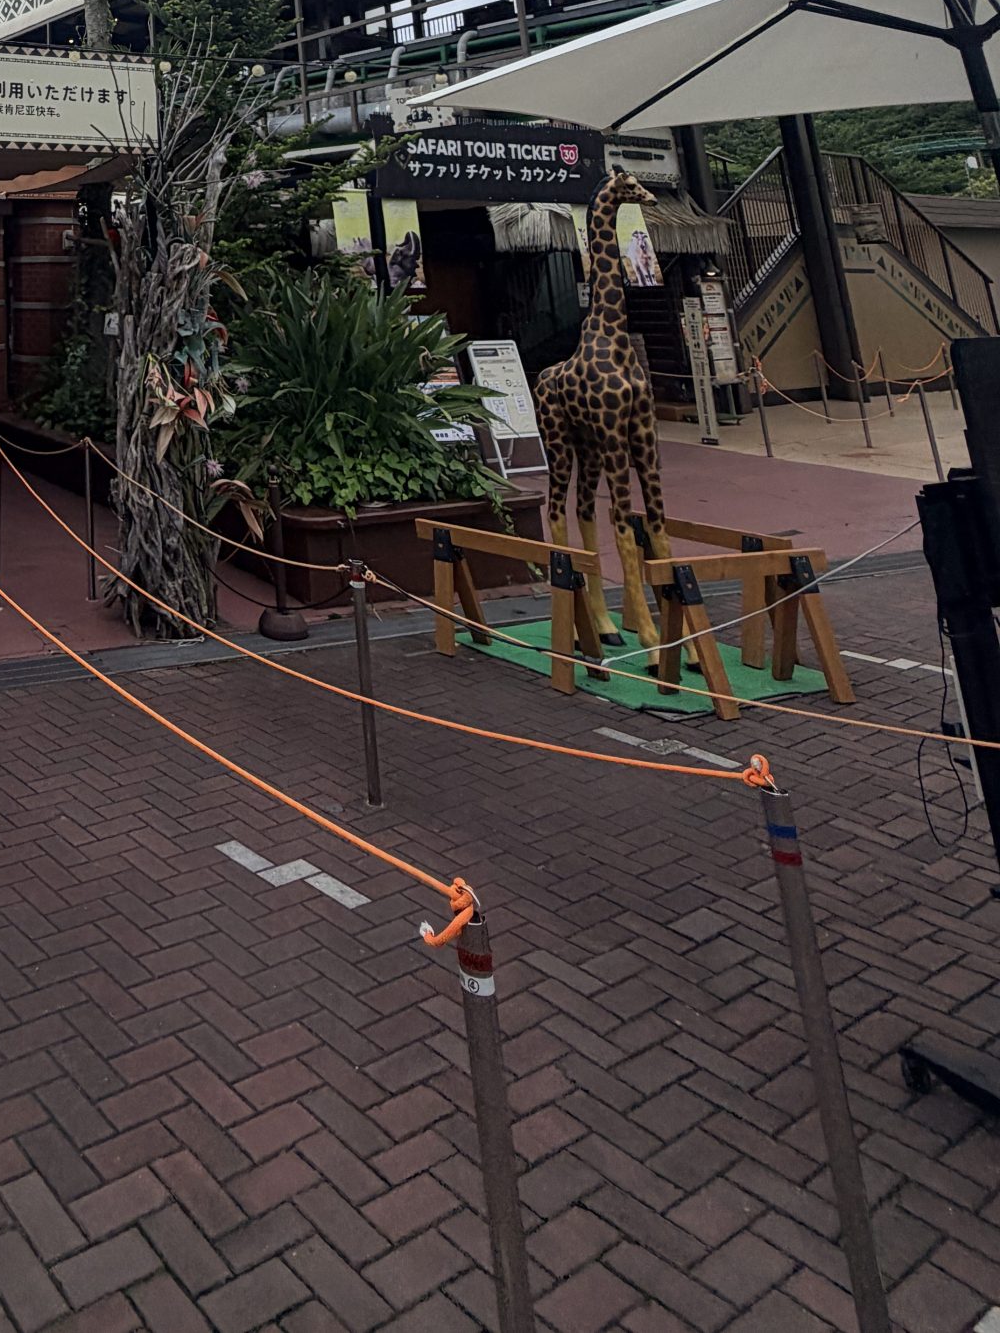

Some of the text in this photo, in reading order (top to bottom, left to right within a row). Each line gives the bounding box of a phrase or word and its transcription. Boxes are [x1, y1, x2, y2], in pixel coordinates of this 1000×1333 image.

[407, 138, 462, 156] SAFARI
[464, 140, 506, 158] TOUR
[510, 143, 557, 161] TICKET
[408, 160, 581, 183] サファリ チケット カウンター
